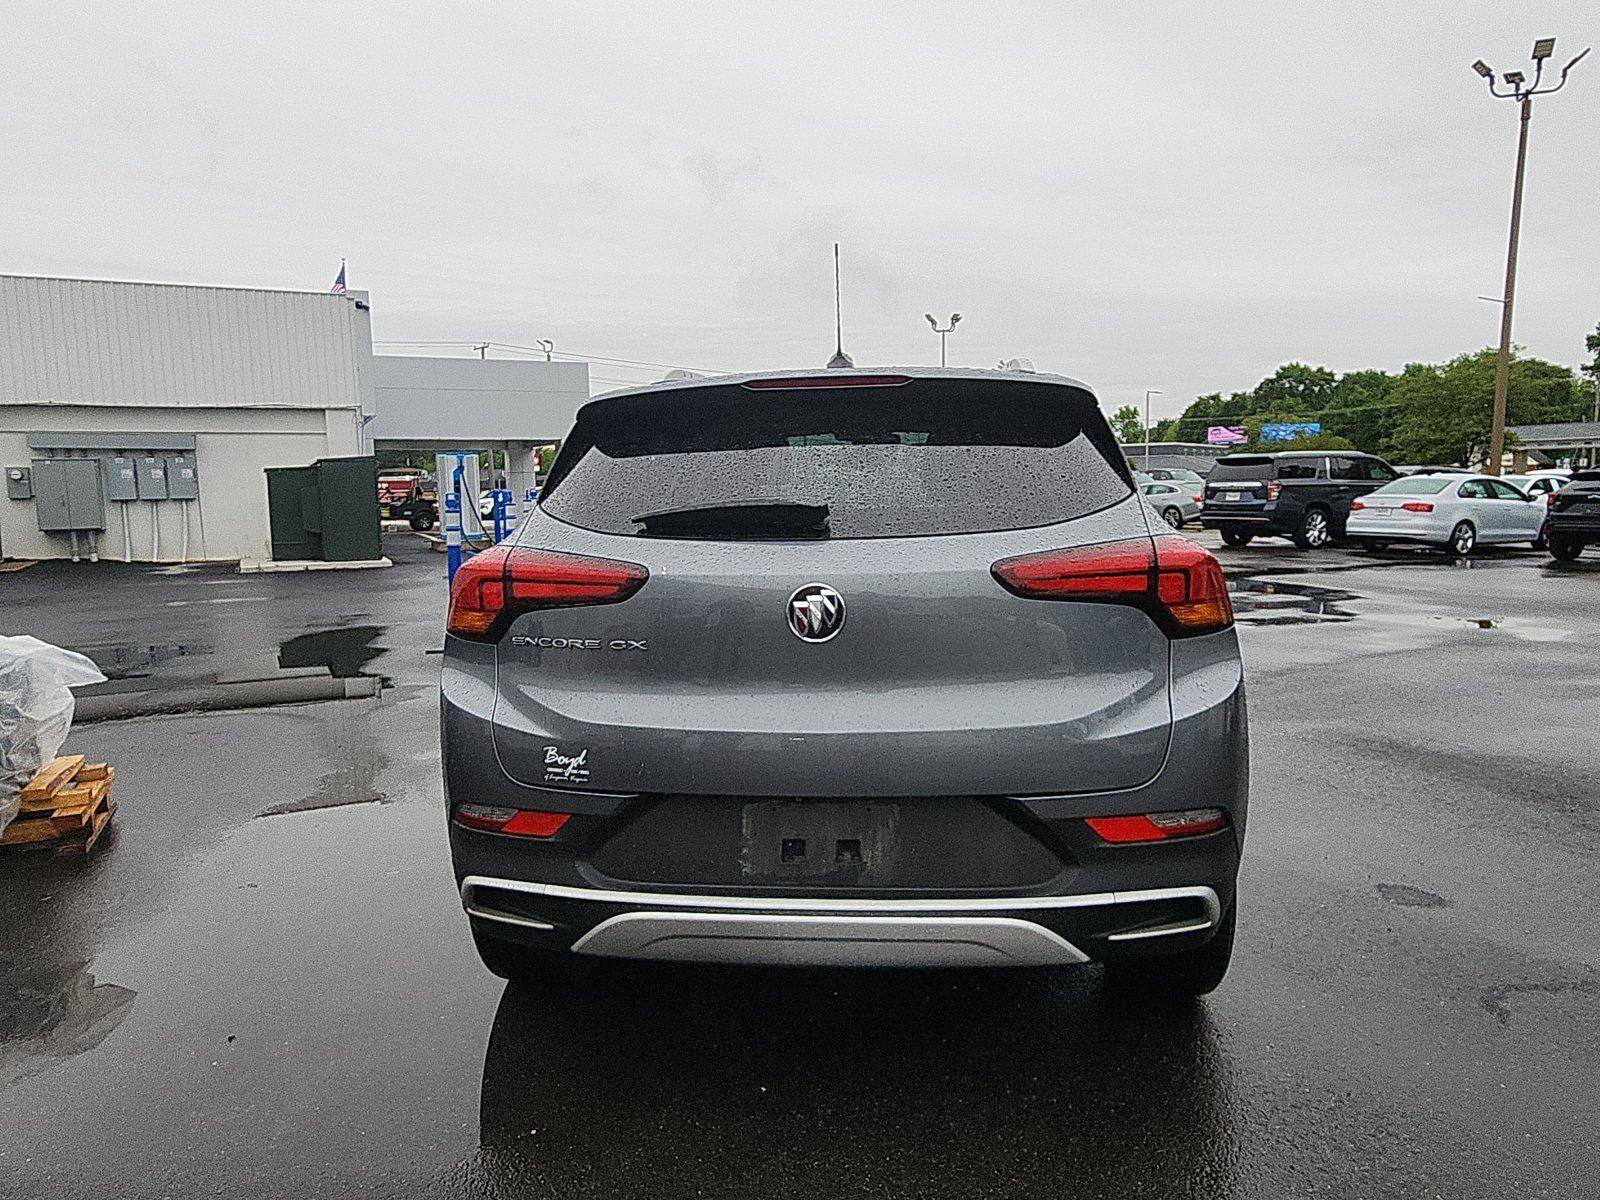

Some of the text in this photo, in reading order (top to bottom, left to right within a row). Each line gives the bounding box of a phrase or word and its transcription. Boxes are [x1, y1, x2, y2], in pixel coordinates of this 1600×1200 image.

[511, 636, 648, 650] ENCORE GX
[543, 746, 588, 776] Boyd
